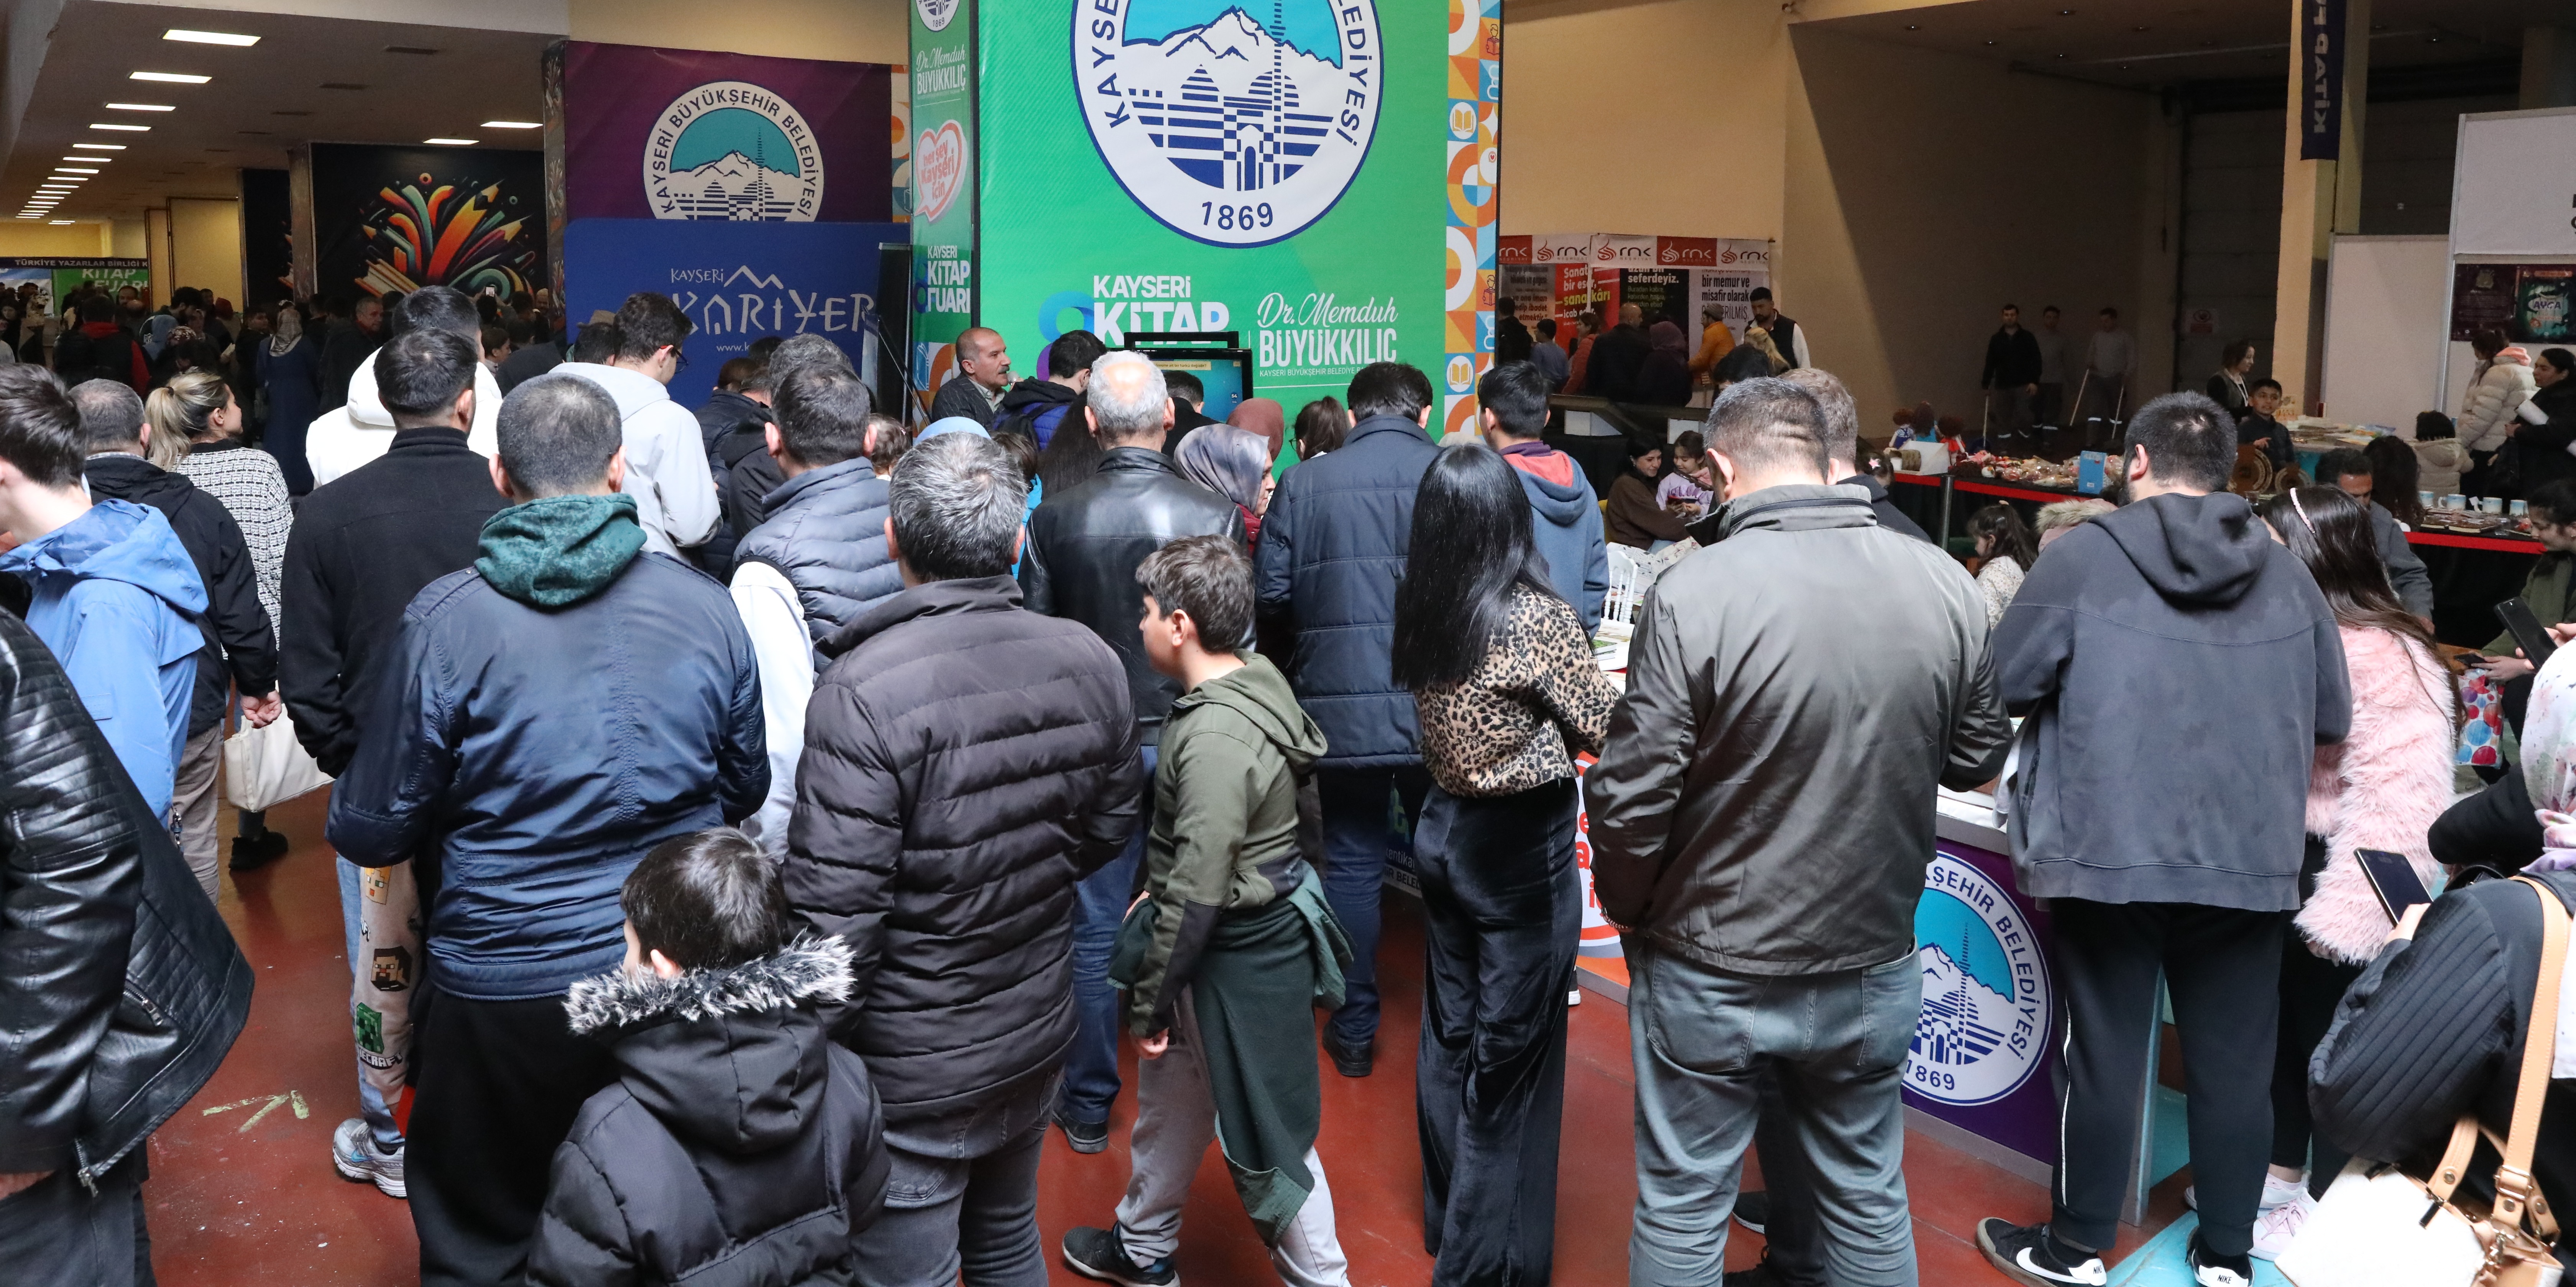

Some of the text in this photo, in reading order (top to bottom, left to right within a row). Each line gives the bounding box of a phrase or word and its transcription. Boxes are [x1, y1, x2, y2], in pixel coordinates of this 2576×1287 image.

[933, 17, 945, 27] 1869
[916, 44, 966, 72] Dr. Memduh
[1092, 0, 1130, 128] KAYSE
[652, 89, 817, 217] KAYSERİ BÜYÜKŞEHİR BELEDİYESİ
[1201, 201, 1274, 230] 1869
[928, 245, 957, 259] KAYSERİ
[671, 268, 724, 283] KAYSERİ
[928, 260, 971, 285] KİTAP
[1564, 264, 1593, 279] Sanat
[1094, 275, 1191, 298] KAYSERİ
[1564, 279, 1597, 291] bir esr,
[1628, 273, 1679, 286] seferdeyiz.
[1702, 274, 1750, 287] bir memur ve
[1564, 288, 1610, 306] sanakârı
[1702, 289, 1750, 302] misafir olarak
[1257, 292, 1399, 328] Dr. Memduh
[1287, 367, 1326, 377] BÜYÜKŞEHİR
[1327, 366, 1355, 374] BELEDİYE
[1995, 915, 2041, 1061] BELEDİYESİ
[1906, 1059, 1955, 1090] 1869
[2093, 1266, 2102, 1274] NIKE
[2217, 1274, 2232, 1284] NIKE
